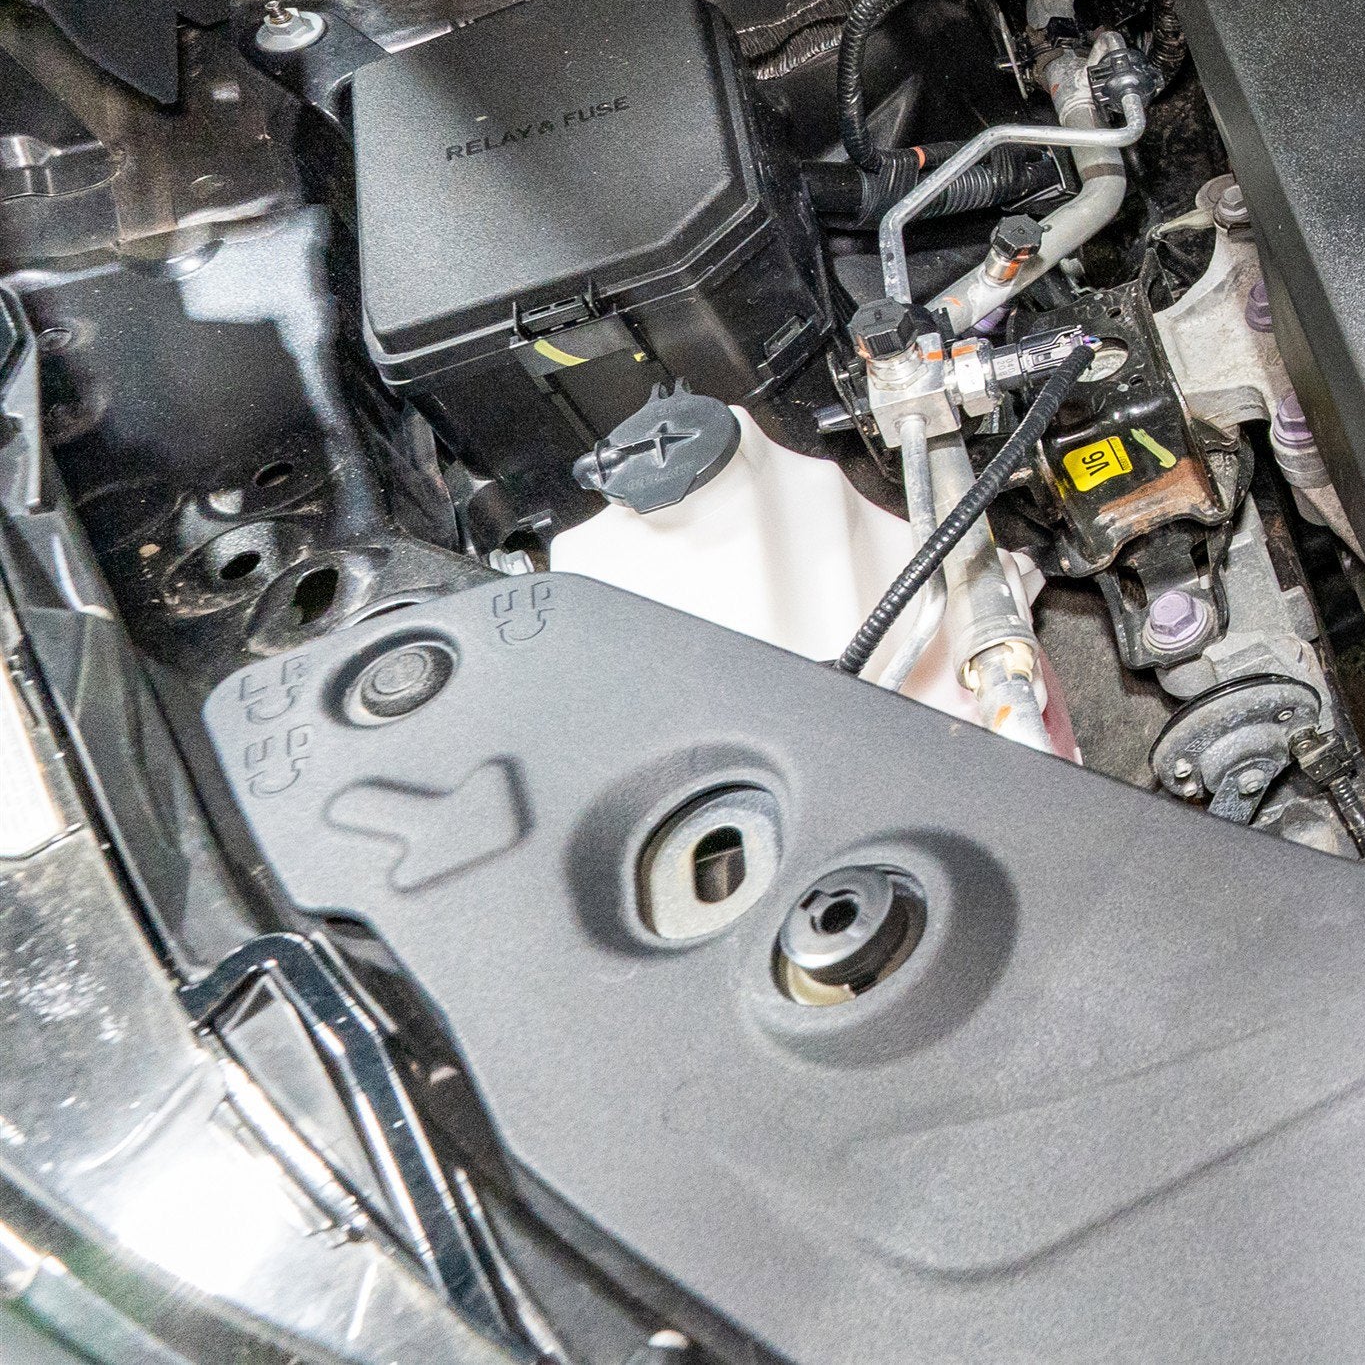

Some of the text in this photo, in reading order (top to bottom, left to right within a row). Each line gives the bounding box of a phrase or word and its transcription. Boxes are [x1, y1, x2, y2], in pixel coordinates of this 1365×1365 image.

[445, 124, 533, 161] RELAY
[563, 96, 630, 127] FUSE
[1081, 450, 1110, 477] V6
